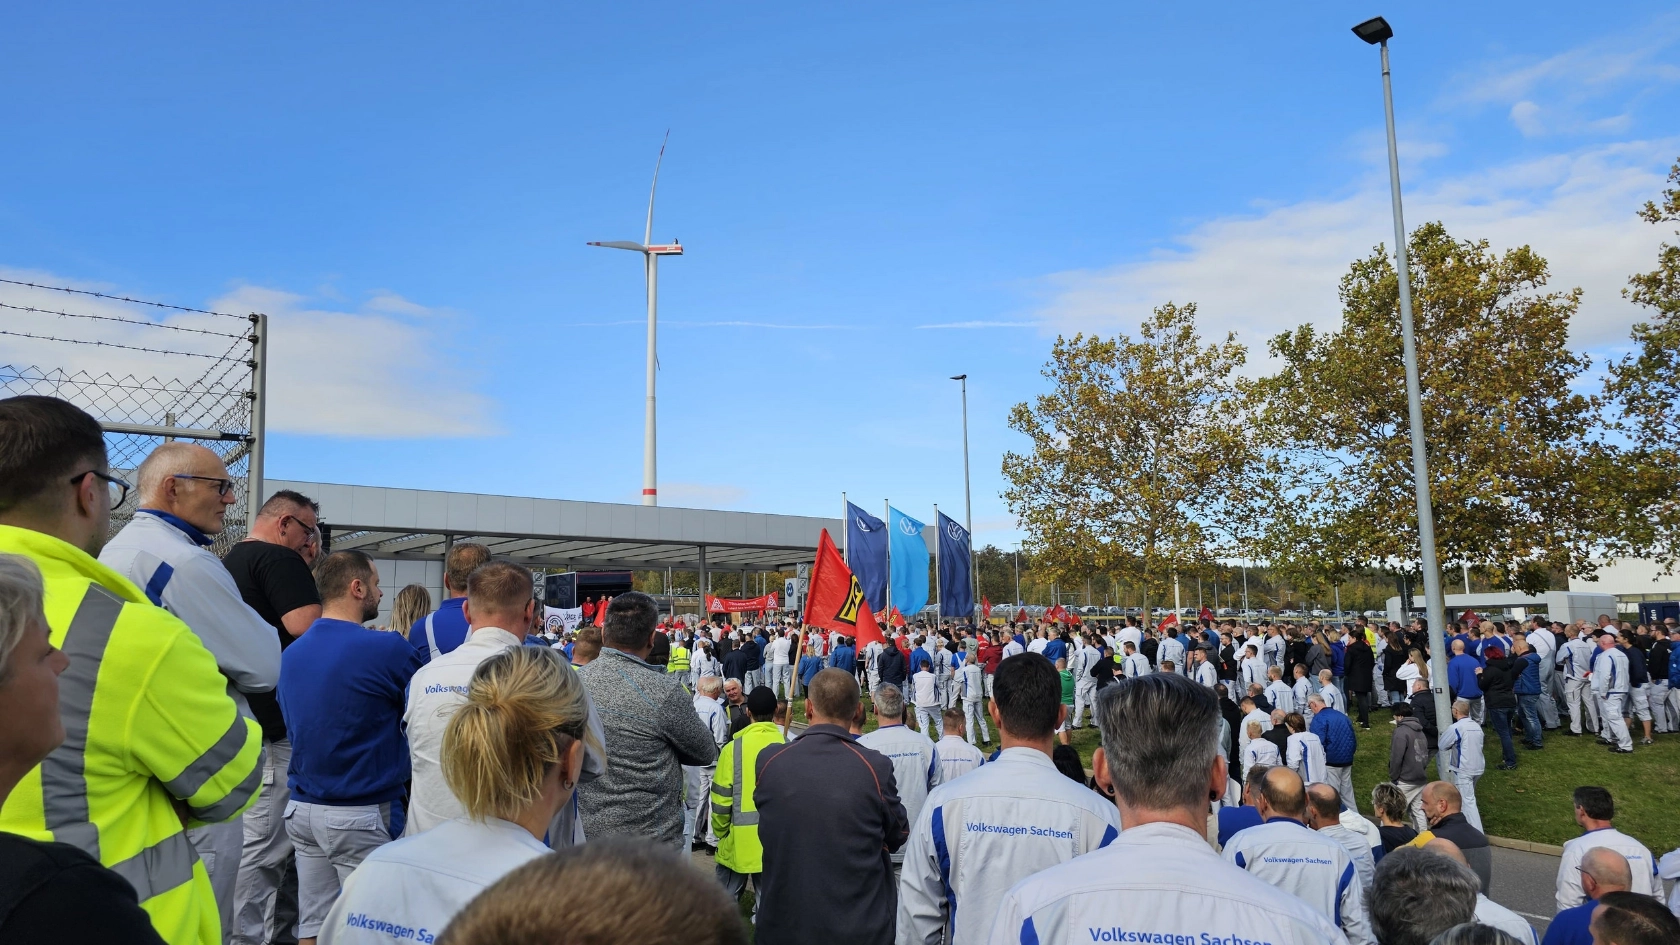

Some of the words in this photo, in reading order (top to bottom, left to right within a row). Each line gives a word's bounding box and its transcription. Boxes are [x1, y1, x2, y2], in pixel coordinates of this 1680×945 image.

[425, 684, 468, 694] Volkswag
[966, 822, 1027, 836] Volkswagen
[1030, 826, 1073, 839] Sachsen
[1305, 857, 1332, 865] Sachsen
[347, 912, 415, 939] Volkswagen
[1089, 927, 1195, 945] Volkswagen
